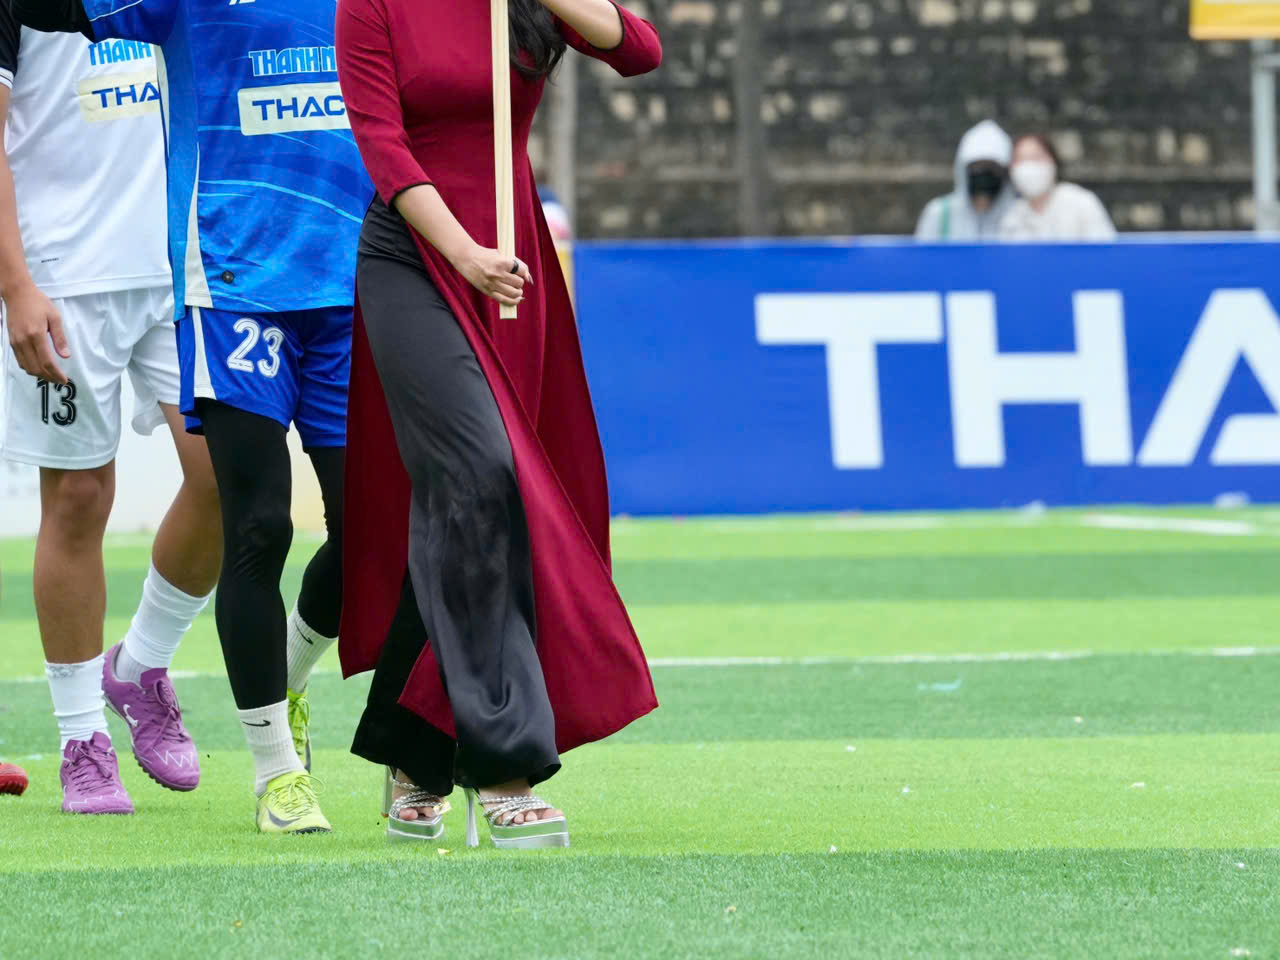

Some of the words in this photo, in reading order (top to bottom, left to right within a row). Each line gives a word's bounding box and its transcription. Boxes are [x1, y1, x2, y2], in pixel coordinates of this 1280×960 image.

[248, 47, 320, 76] THANH
[227, 318, 285, 378] 23
[35, 377, 77, 426] 13
[754, 288, 1280, 469] THA
